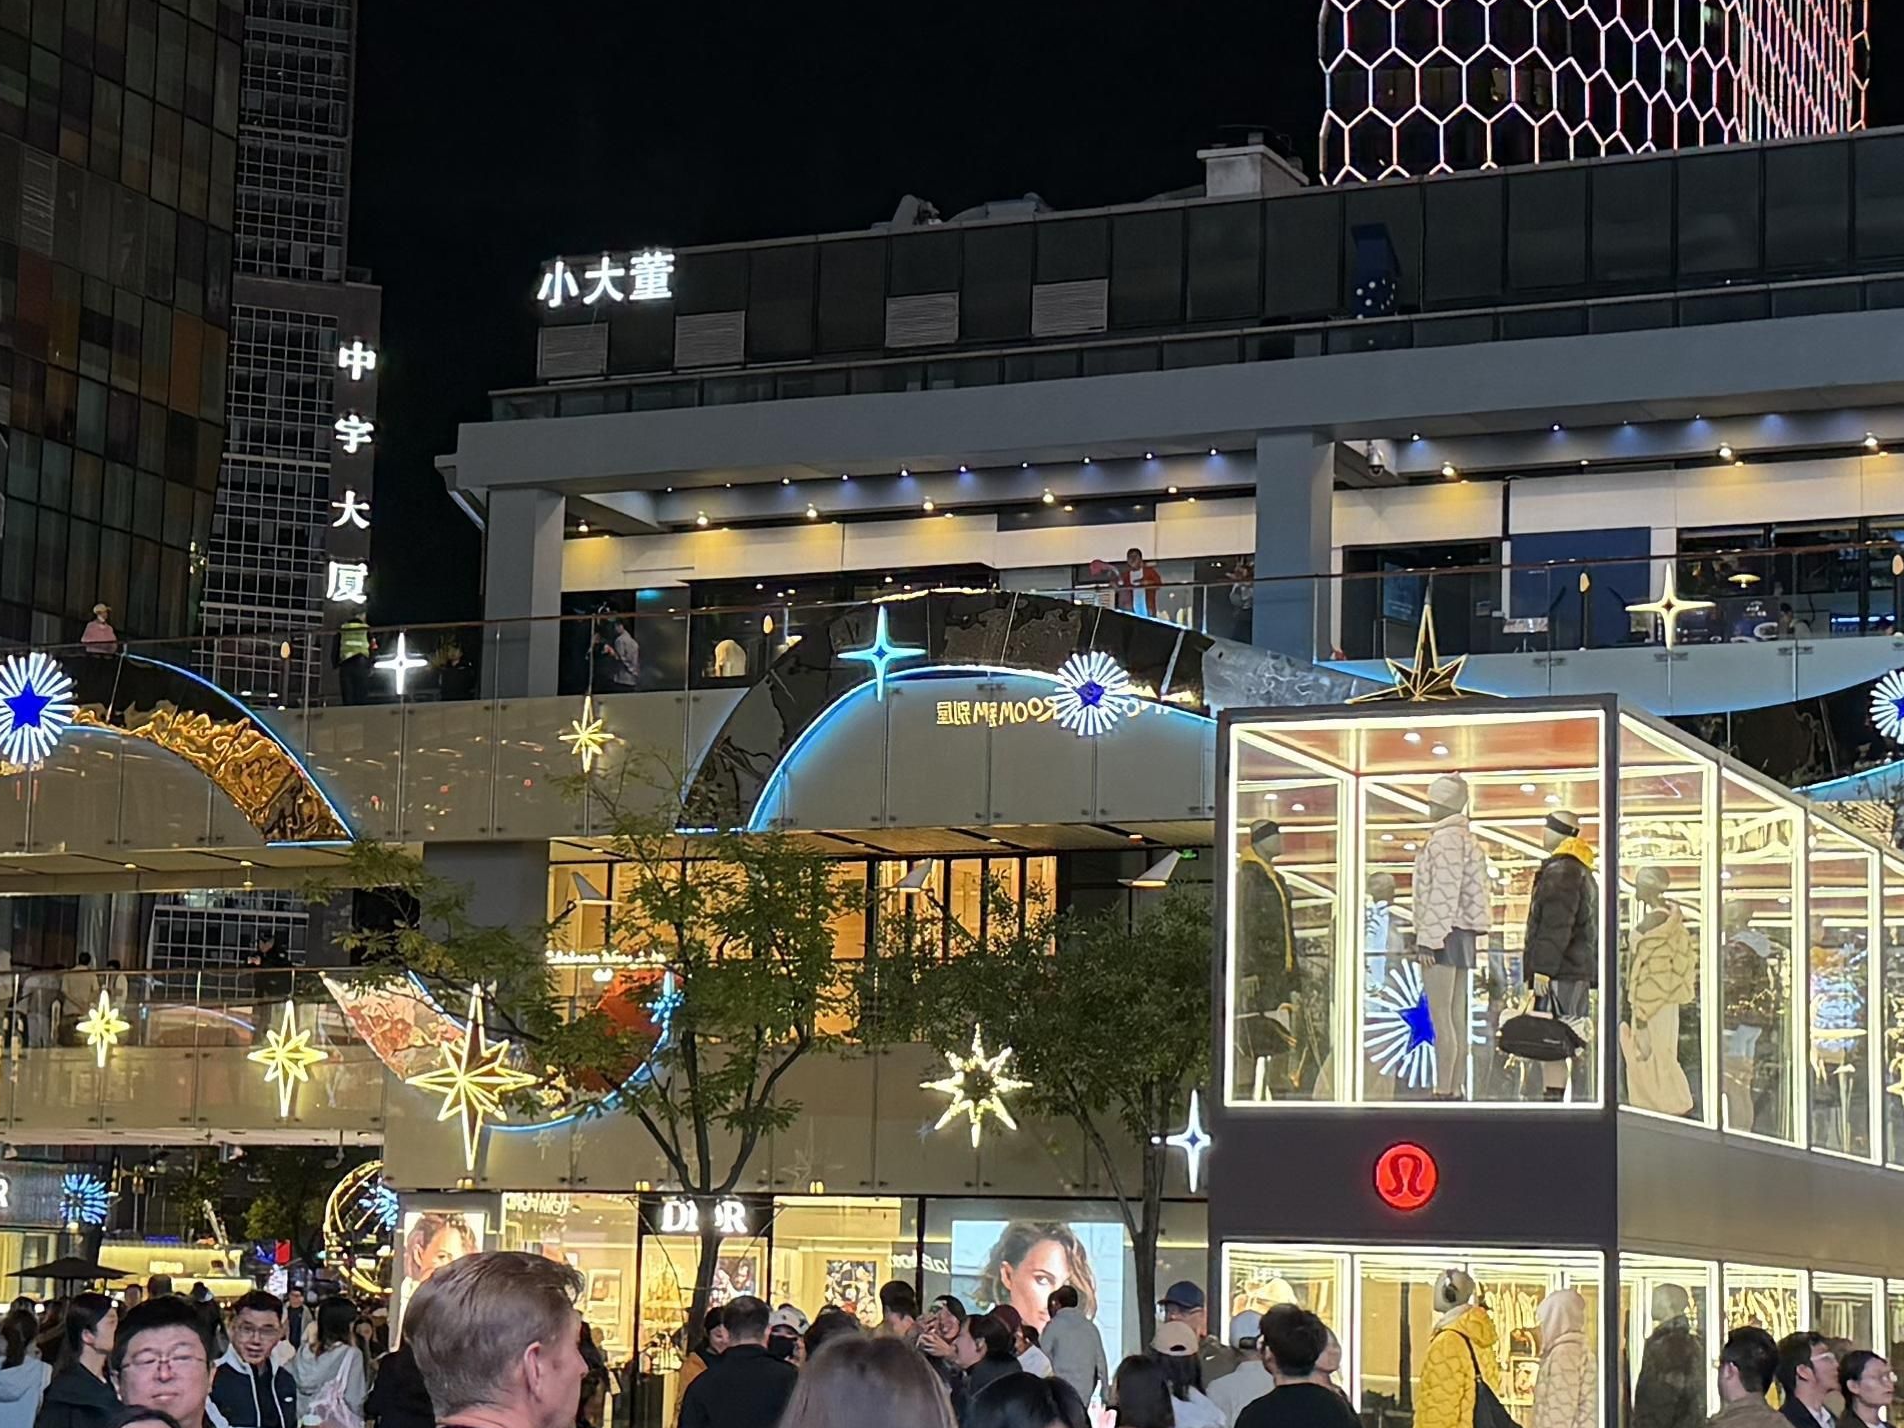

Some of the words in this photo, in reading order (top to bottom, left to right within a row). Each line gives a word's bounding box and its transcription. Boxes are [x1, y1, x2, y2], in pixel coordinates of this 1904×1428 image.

[536, 251, 676, 309] 小大董
[325, 340, 377, 605] 中宇大厦
